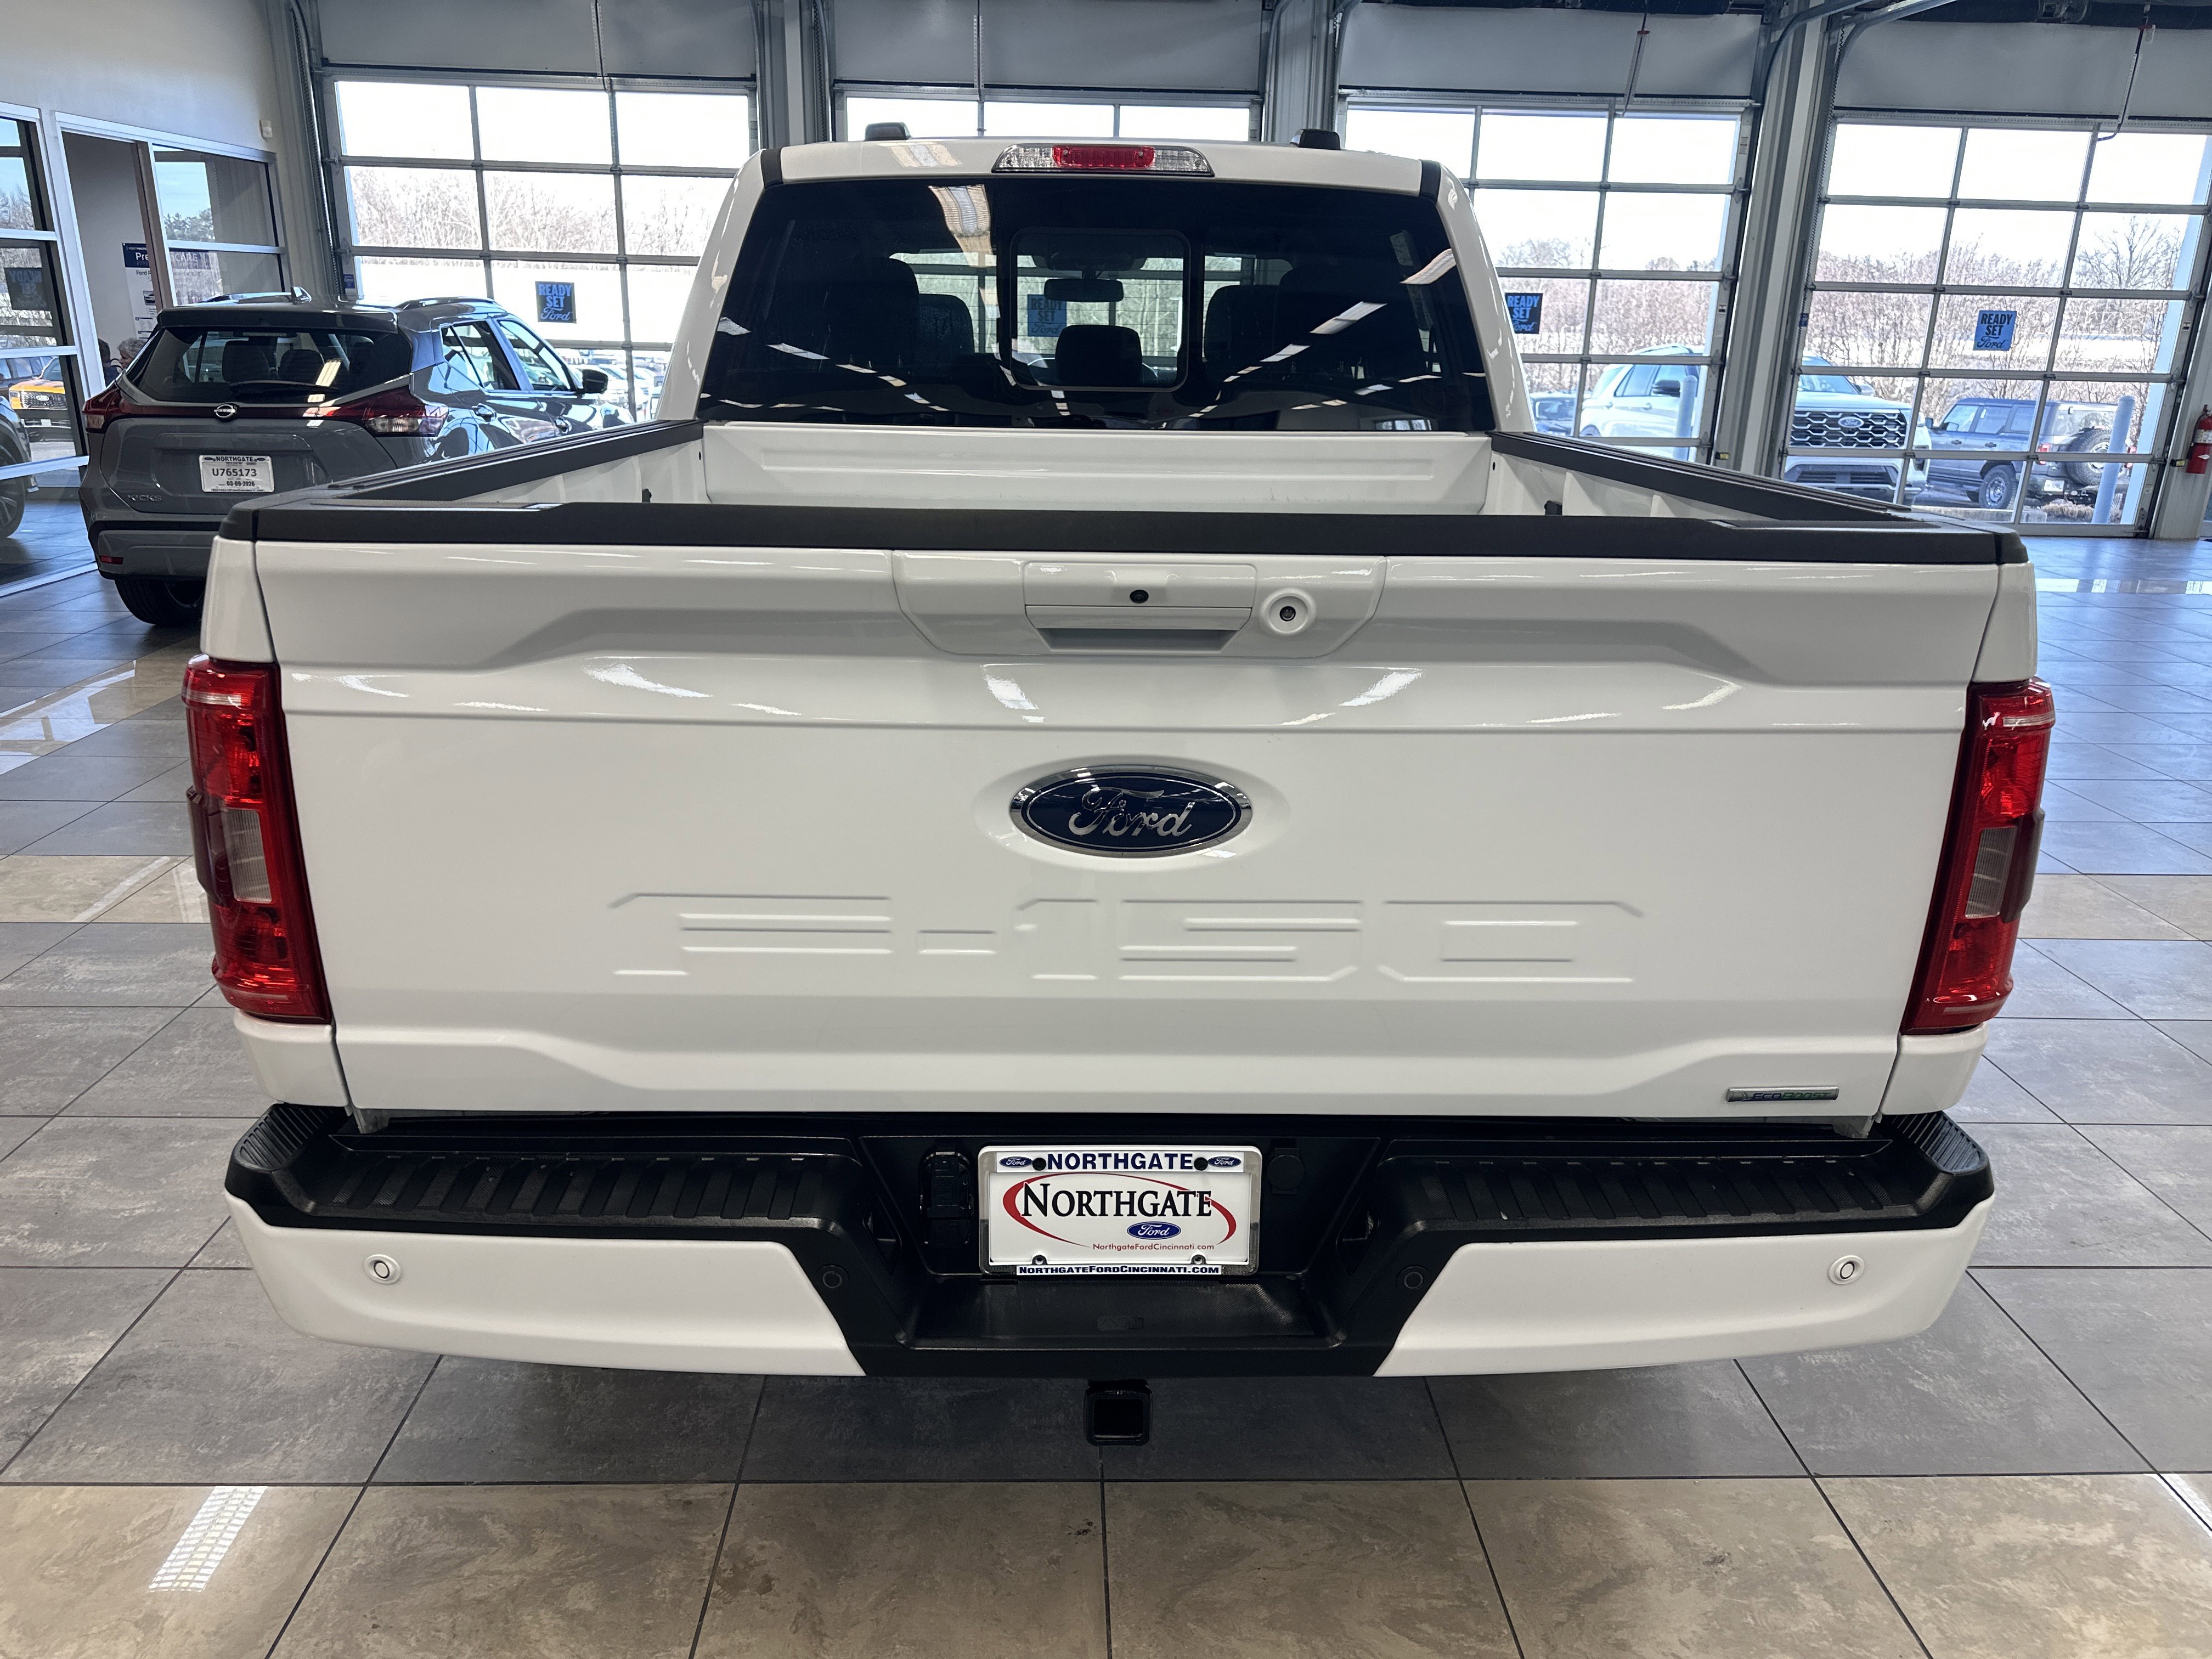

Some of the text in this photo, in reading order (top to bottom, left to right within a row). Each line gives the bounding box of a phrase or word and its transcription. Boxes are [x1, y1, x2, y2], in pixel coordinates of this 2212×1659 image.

[538, 284, 571, 296] READY
[546, 296, 565, 307] SET
[1508, 296, 1540, 307] READY
[540, 307, 571, 320] Ford
[1037, 311, 1056, 322] SET
[1513, 307, 1531, 318] SET
[1981, 313, 2013, 325] READY
[1985, 325, 2004, 336] SET
[1977, 336, 2009, 348] Ford
[212, 468, 257, 477] U765173
[1068, 786, 1196, 837] Ford
[1047, 1153, 1193, 1170] NORTHGATE
[1021, 1183, 1212, 1217] NORTHGATE
